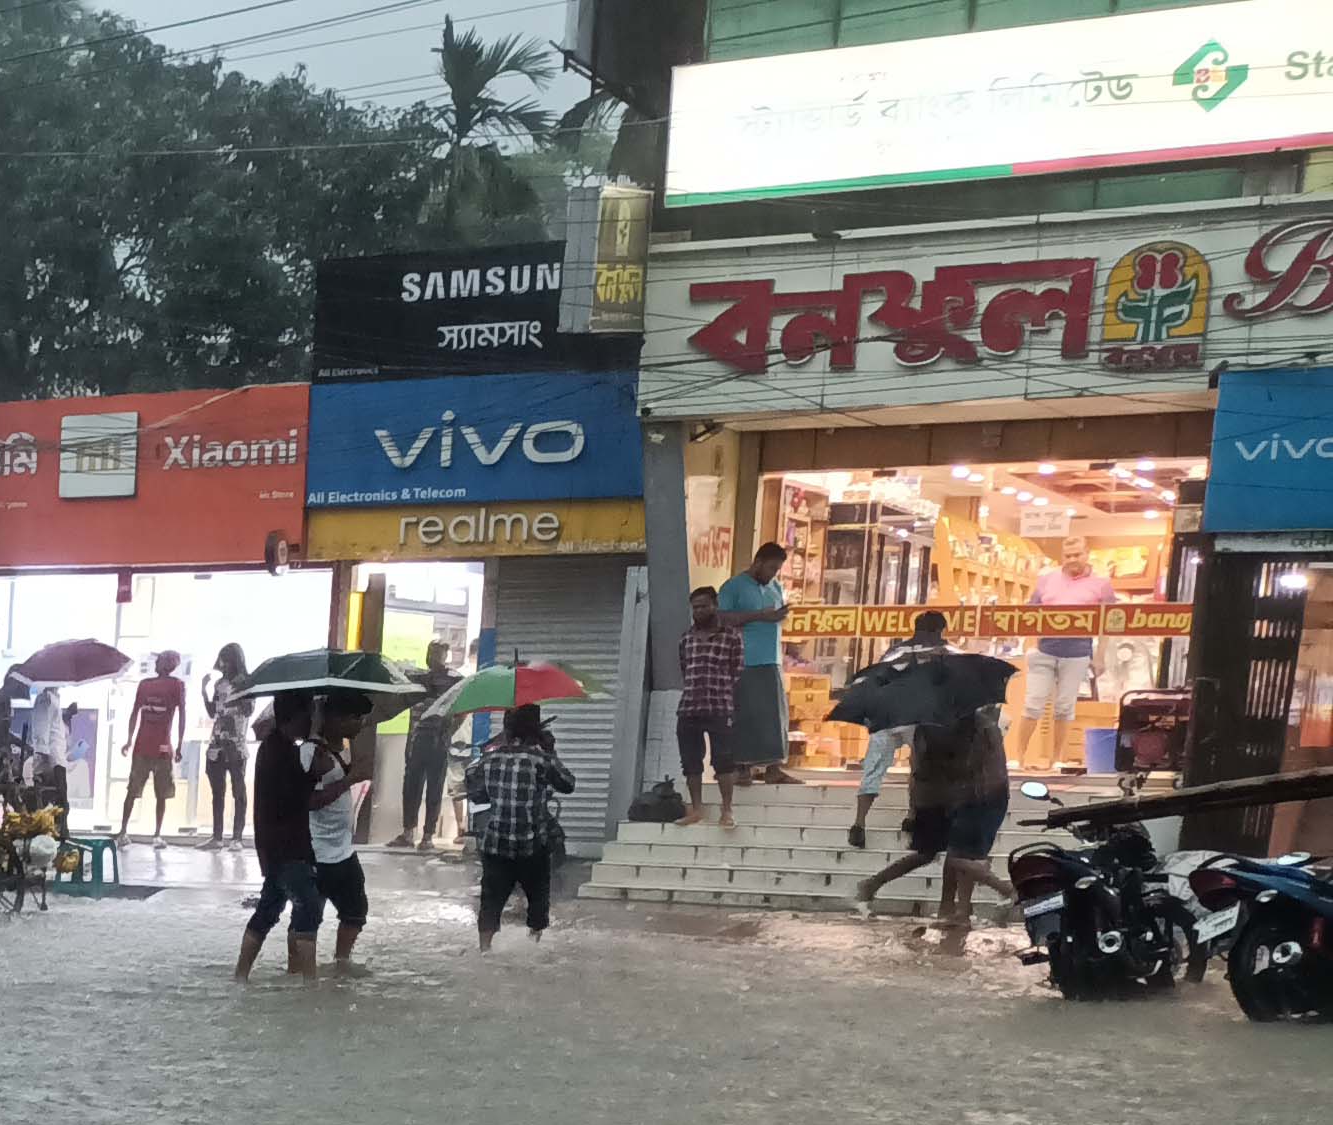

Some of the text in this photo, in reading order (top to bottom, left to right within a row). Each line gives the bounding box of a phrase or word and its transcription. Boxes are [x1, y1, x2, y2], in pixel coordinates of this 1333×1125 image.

[400, 262, 562, 302] SAMSUN
[689, 257, 1099, 374] বনফুল
[436, 320, 544, 351] স্যামসাং
[163, 428, 299, 471] Xiaomi
[374, 409, 585, 469] vivo
[307, 486, 466, 504] All Electronics & Telecom
[398, 508, 560, 546] realme
[863, 609, 976, 633] WELME
